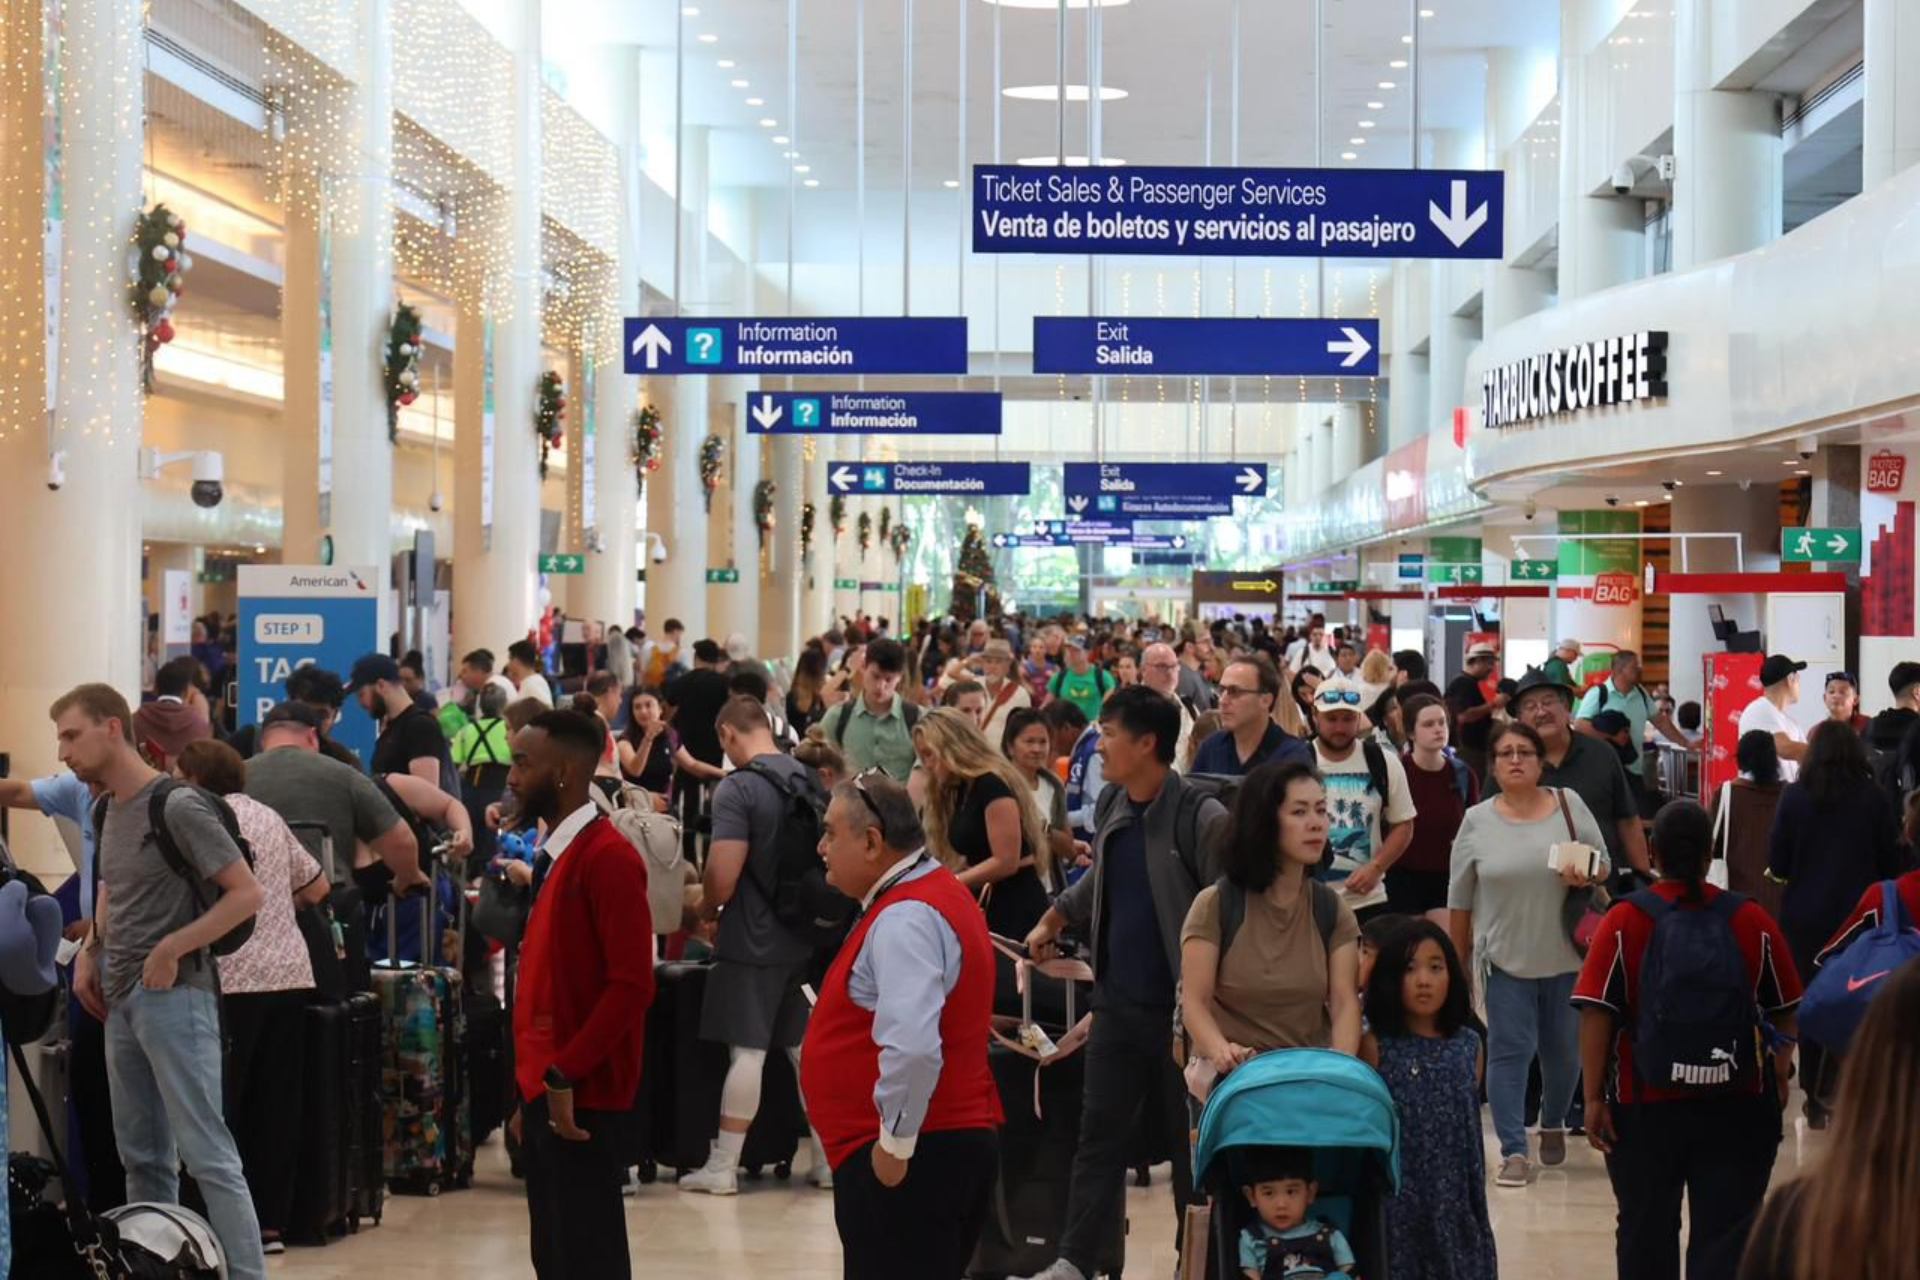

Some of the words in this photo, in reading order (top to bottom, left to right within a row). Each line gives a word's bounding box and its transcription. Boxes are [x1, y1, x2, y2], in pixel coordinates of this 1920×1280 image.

[981, 175, 1042, 202] Ticket
[1047, 175, 1102, 203] Sales
[1107, 176, 1125, 203] &
[1130, 177, 1237, 209] Passenger
[1241, 178, 1327, 206] Services
[981, 209, 1048, 238] Venta
[1053, 210, 1082, 238] de
[1086, 210, 1170, 240] boletos
[1174, 218, 1189, 245] y
[1194, 212, 1292, 242] servicios
[1296, 213, 1316, 241] al
[1320, 215, 1416, 248] pasajero
[738, 322, 838, 342] Information
[1097, 322, 1129, 342] Exit
[737, 345, 854, 366] Información
[1096, 345, 1154, 366] Salida
[1482, 349, 1562, 428] STARBUCKS
[1565, 332, 1651, 410] COFFEE
[831, 395, 906, 411] Information
[830, 412, 918, 428] Información
[1101, 465, 1120, 477] Exit
[1868, 470, 1900, 488] BAG
[893, 477, 985, 492] Documentación
[1100, 478, 1136, 492] Salida
[289, 575, 349, 588] American
[1595, 585, 1631, 602] BAG
[263, 622, 299, 635] STEP
[305, 622, 312, 635] 1
[1671, 1062, 1730, 1084] PUMA
